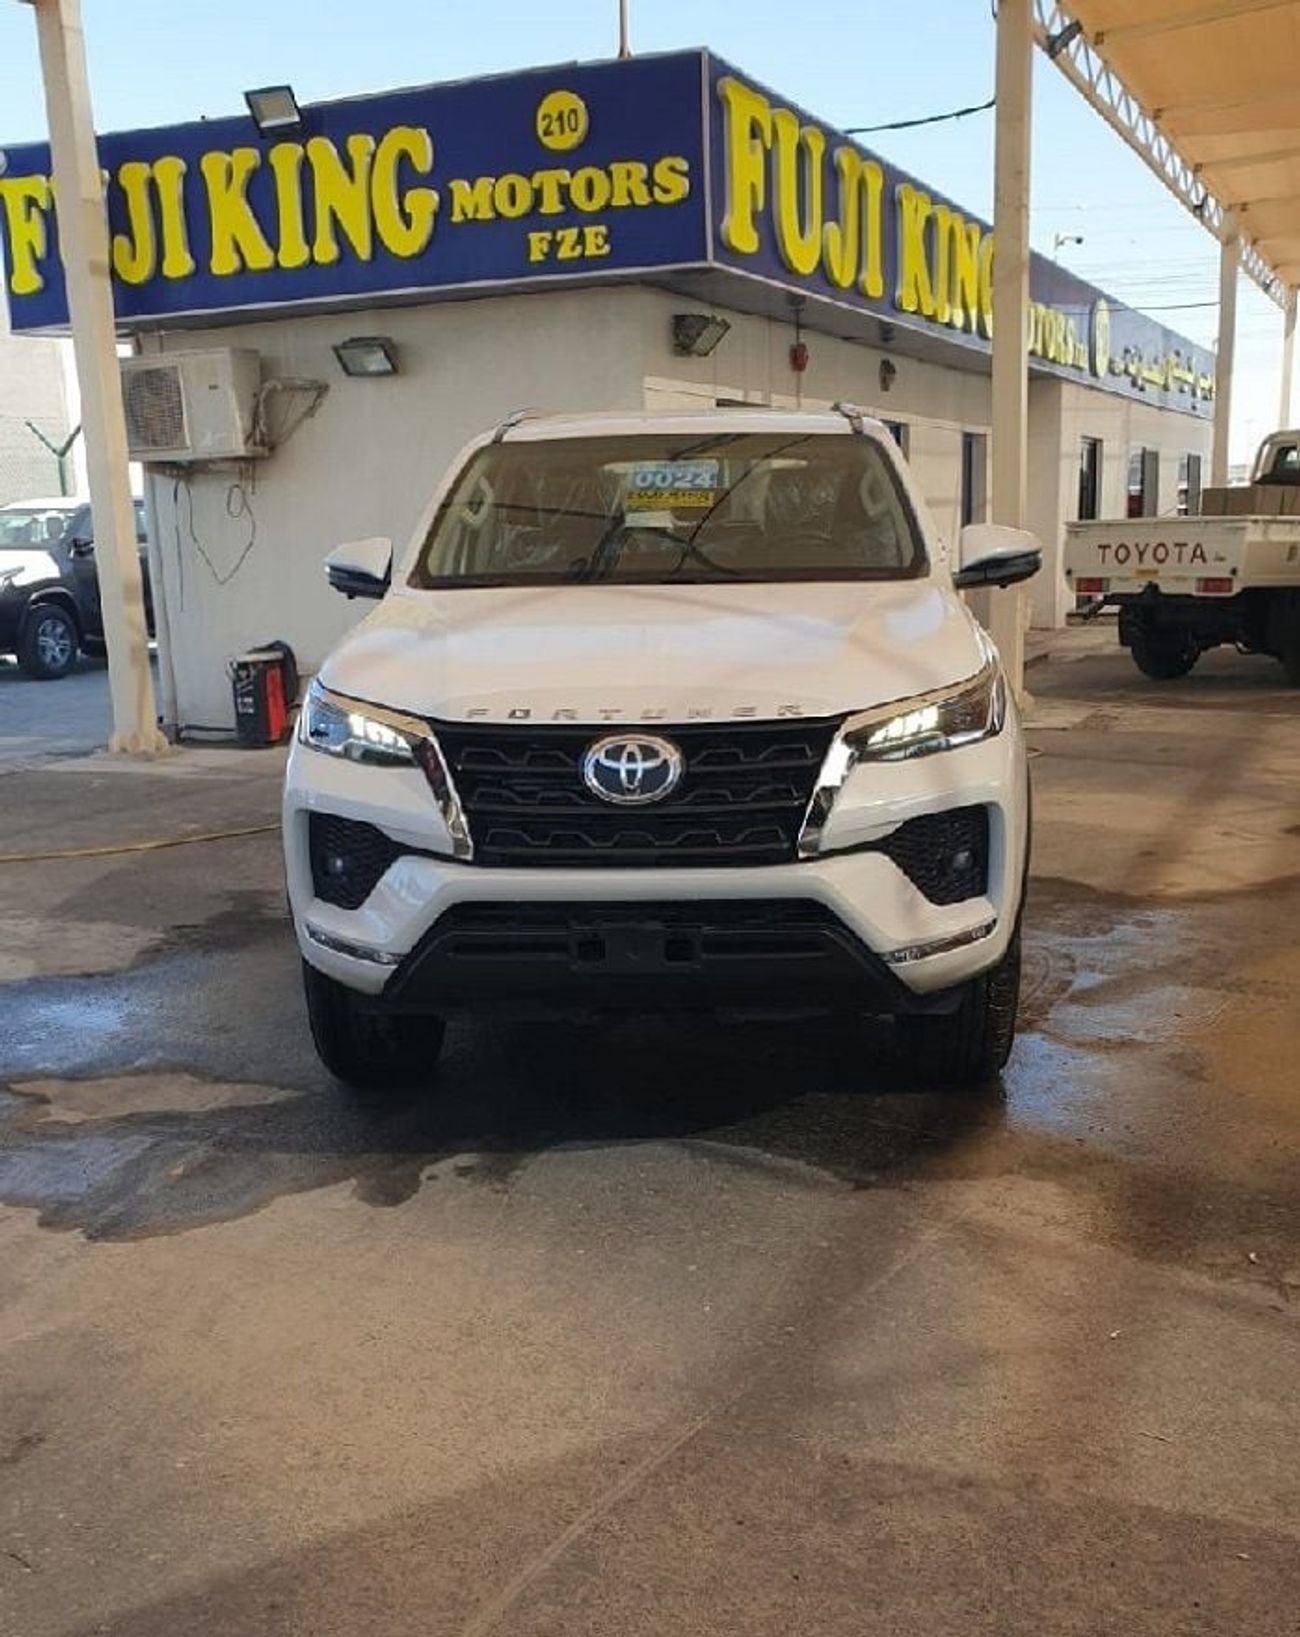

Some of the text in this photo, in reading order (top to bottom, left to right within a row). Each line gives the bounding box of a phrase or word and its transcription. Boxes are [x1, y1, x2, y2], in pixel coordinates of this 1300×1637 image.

[541, 108, 579, 137] 210
[449, 156, 690, 223] MOTORS
[717, 76, 884, 298] FUJI
[0, 126, 439, 295] FJI KING
[528, 225, 611, 262] FZE
[1098, 543, 1207, 564] TOYOTA
[465, 703, 804, 720] FORTUNER
